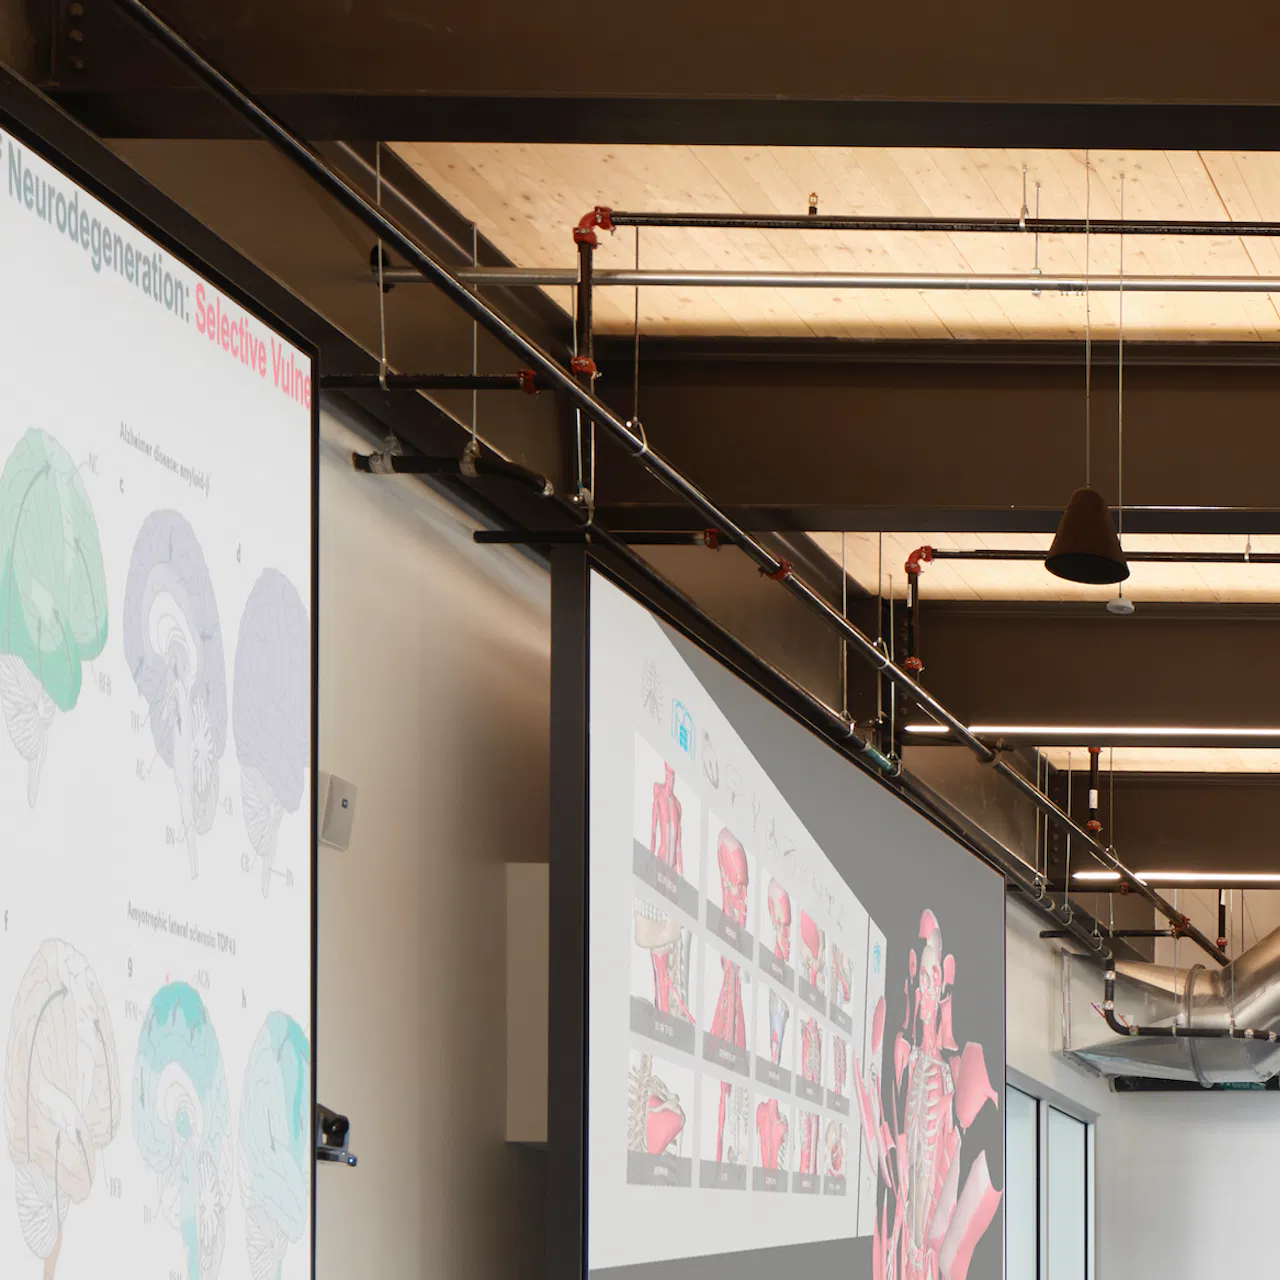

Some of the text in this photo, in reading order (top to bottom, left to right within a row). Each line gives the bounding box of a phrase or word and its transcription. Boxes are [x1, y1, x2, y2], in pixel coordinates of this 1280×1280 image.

[8, 140, 190, 323] Neurodegeneration:
[195, 282, 267, 378] Selective
[127, 899, 168, 935] Amyotrophic
[168, 911, 189, 939] lateral
[127, 957, 133, 979] g
